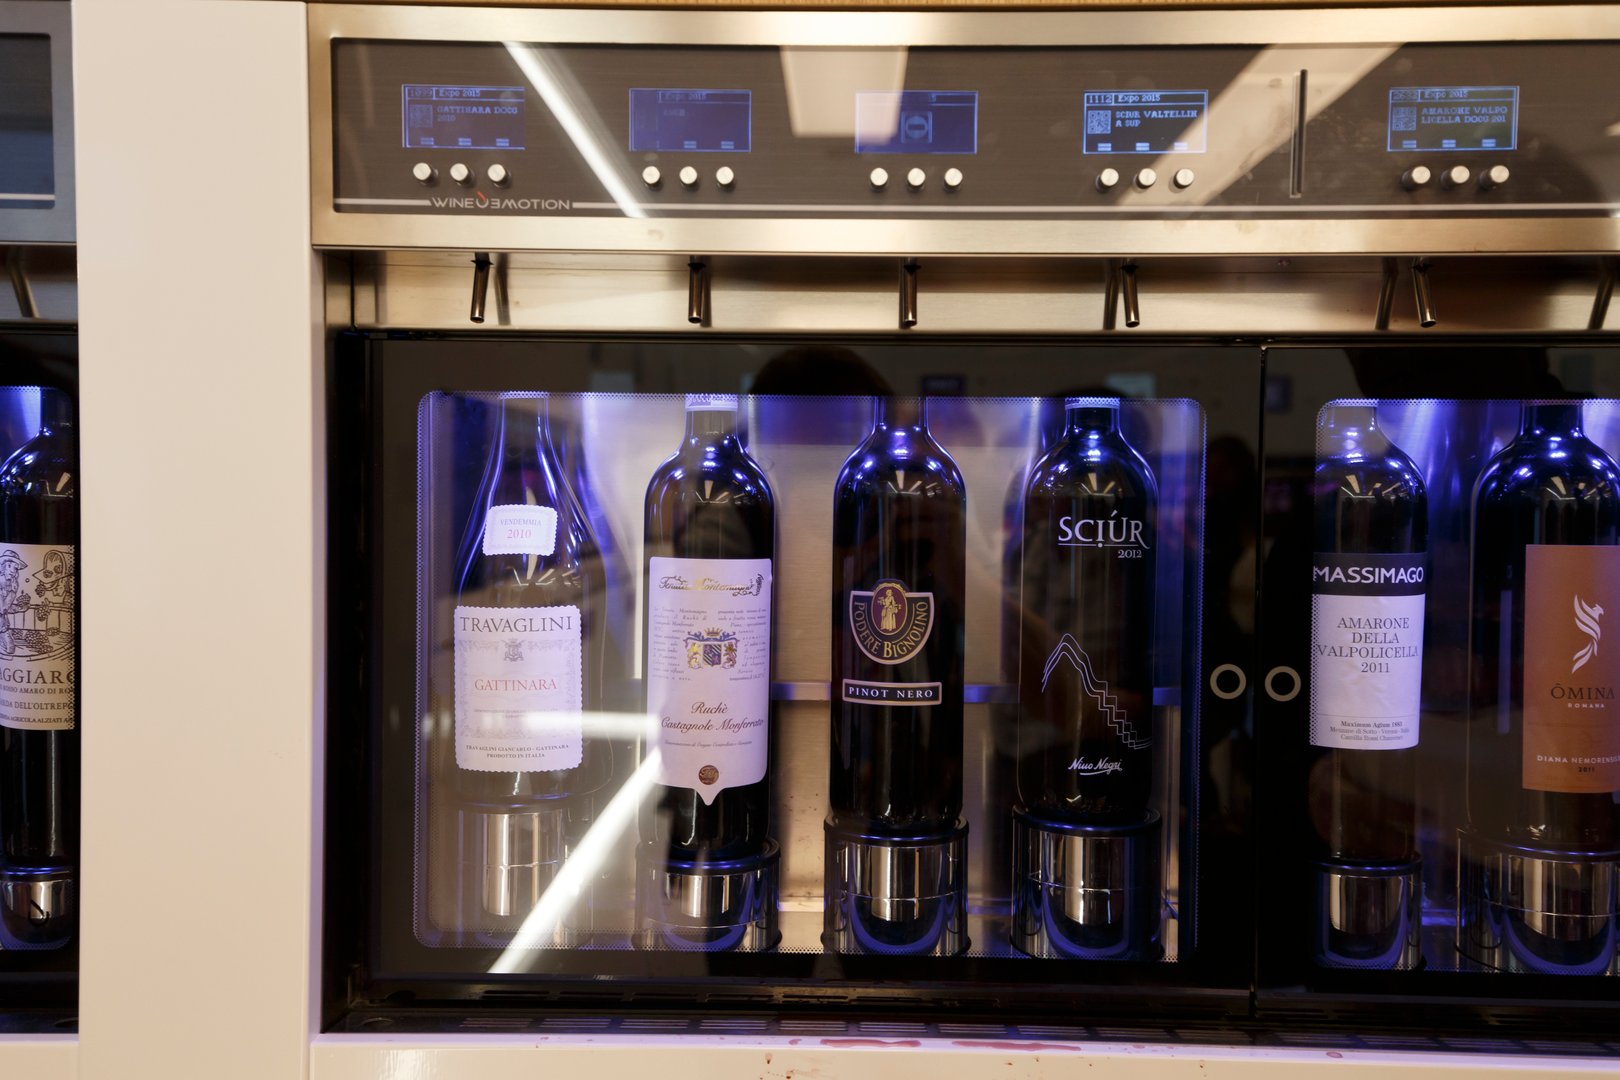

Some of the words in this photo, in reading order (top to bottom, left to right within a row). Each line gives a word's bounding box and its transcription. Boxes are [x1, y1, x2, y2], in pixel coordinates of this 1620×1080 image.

[439, 89, 460, 98] Expo
[462, 89, 481, 97] 2015
[1118, 95, 1140, 103] Expo
[1424, 90, 1447, 100] Expo
[1473, 106, 1508, 114] VALPO
[506, 529, 532, 539] 2010
[1117, 549, 1142, 559] 2012
[1312, 566, 1424, 584] MASSIMAGO
[460, 616, 573, 633] TRAVAGLINI
[854, 601, 882, 655] PODERE
[1337, 617, 1410, 630] AMARONE
[1352, 632, 1400, 644] DELLA
[1361, 662, 1390, 673] 2011
[475, 679, 558, 691] GATTINARA
[849, 687, 889, 698] PINOT
[896, 690, 933, 698] NERO
[661, 716, 713, 733] Castagnole
[715, 717, 764, 733] Monferrato
[466, 744, 497, 752] TRAVAGLINI
[1537, 755, 1568, 763] DIANA
